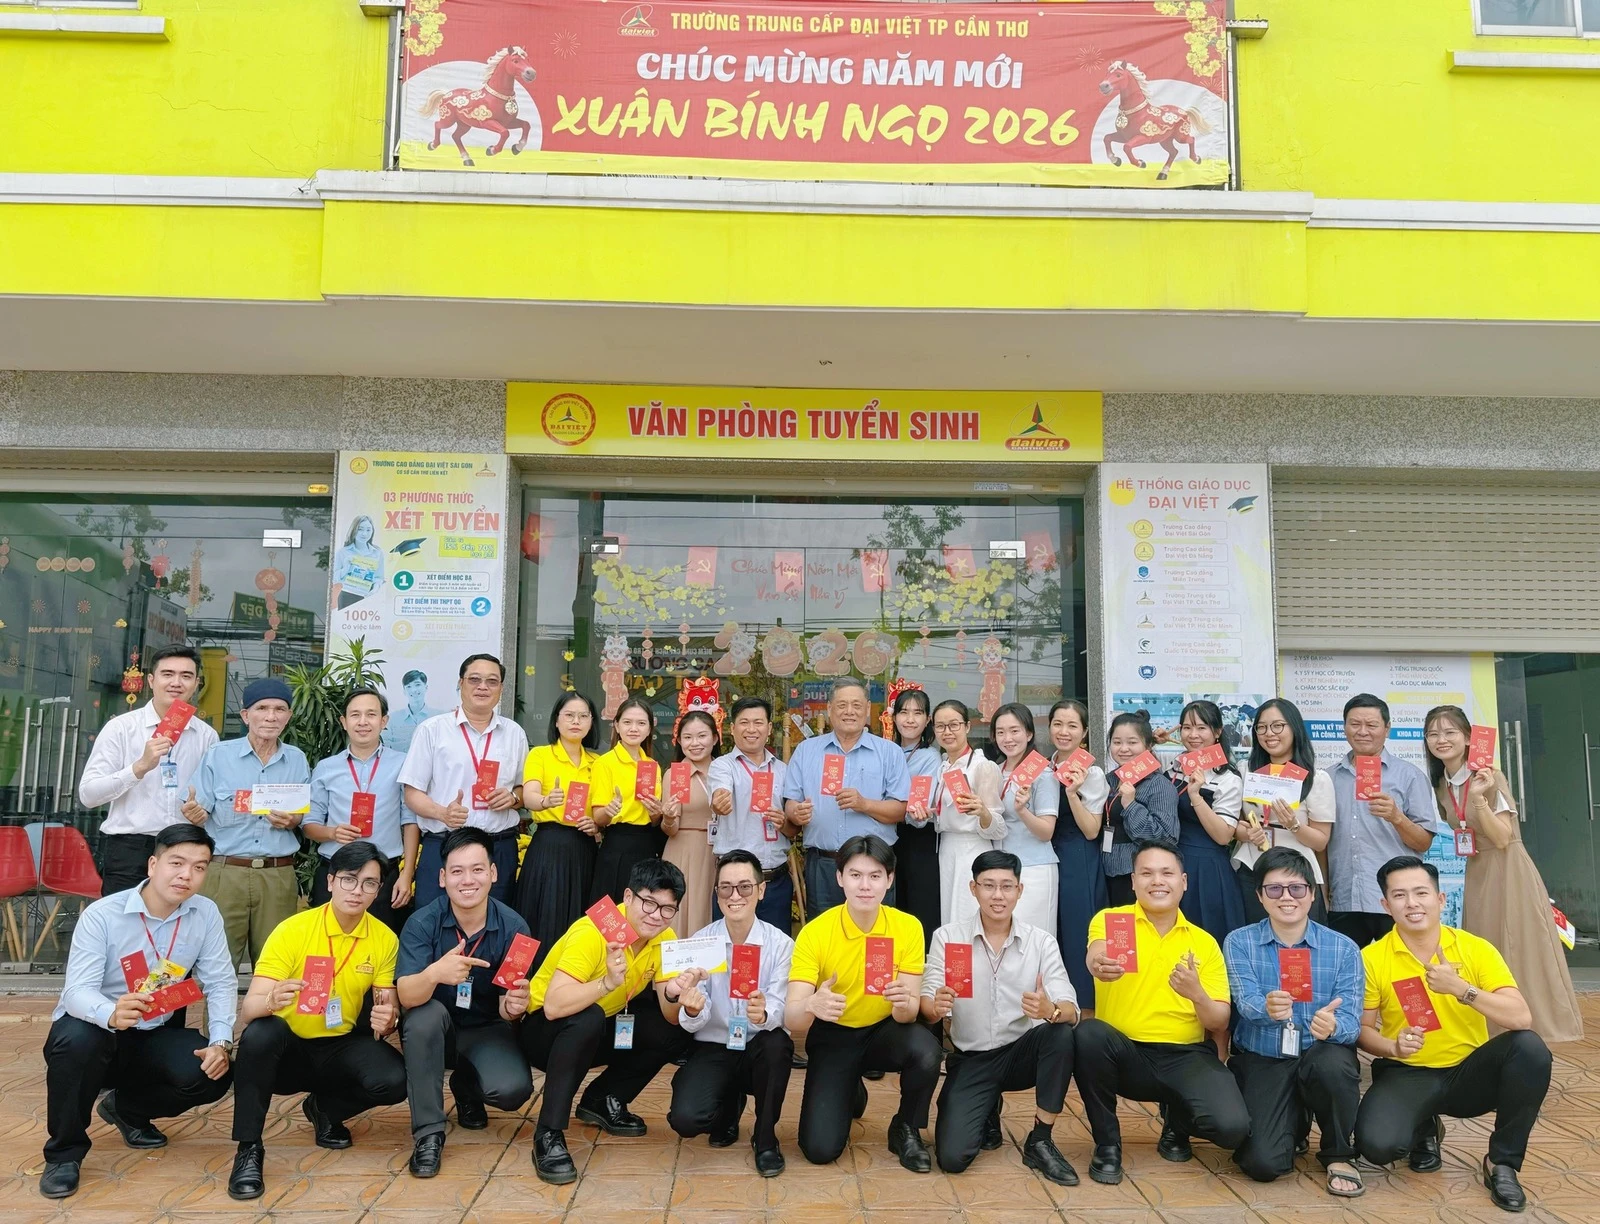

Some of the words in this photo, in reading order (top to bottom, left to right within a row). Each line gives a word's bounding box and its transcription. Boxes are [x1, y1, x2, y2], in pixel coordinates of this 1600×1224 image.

[671, 10, 740, 31] TRƯỜNG
[746, 14, 803, 33] TRUNG
[809, 13, 844, 34] CẤP
[850, 17, 879, 38] ĐẠI
[885, 16, 920, 38] VIỆT
[927, 18, 948, 36] TP
[954, 14, 990, 37] CẦN
[996, 19, 1029, 38] THƠ
[637, 46, 737, 83] CHÚC
[744, 48, 853, 85] MỪNG
[862, 51, 944, 86] NĂM
[953, 53, 1024, 89] MỚI
[551, 88, 691, 139] XUÂN
[704, 90, 828, 143] BÍNH
[842, 103, 949, 151] NGỌ
[963, 106, 1080, 146] 2026
[628, 401, 687, 437] VĂN
[698, 402, 797, 438] PHÒNG
[807, 400, 899, 440] TUYỂN
[910, 411, 980, 440] SINH
[1010, 438, 1065, 447] daiviet
[1116, 477, 1133, 491] HỆ
[1138, 476, 1183, 490] THỐNG
[1188, 478, 1220, 490] GIÁO
[1224, 480, 1251, 492] DỤC
[383, 492, 396, 502] 03
[400, 492, 443, 503] PHƯƠNG
[447, 491, 474, 503] THỨC
[1149, 496, 1176, 511] ĐẠI
[1182, 494, 1219, 511] VIỆT
[385, 507, 424, 529] XÉT
[432, 504, 499, 531] TUYỂN
[399, 574, 409, 586] 1
[476, 601, 486, 612] 2
[344, 610, 381, 621] 100%
